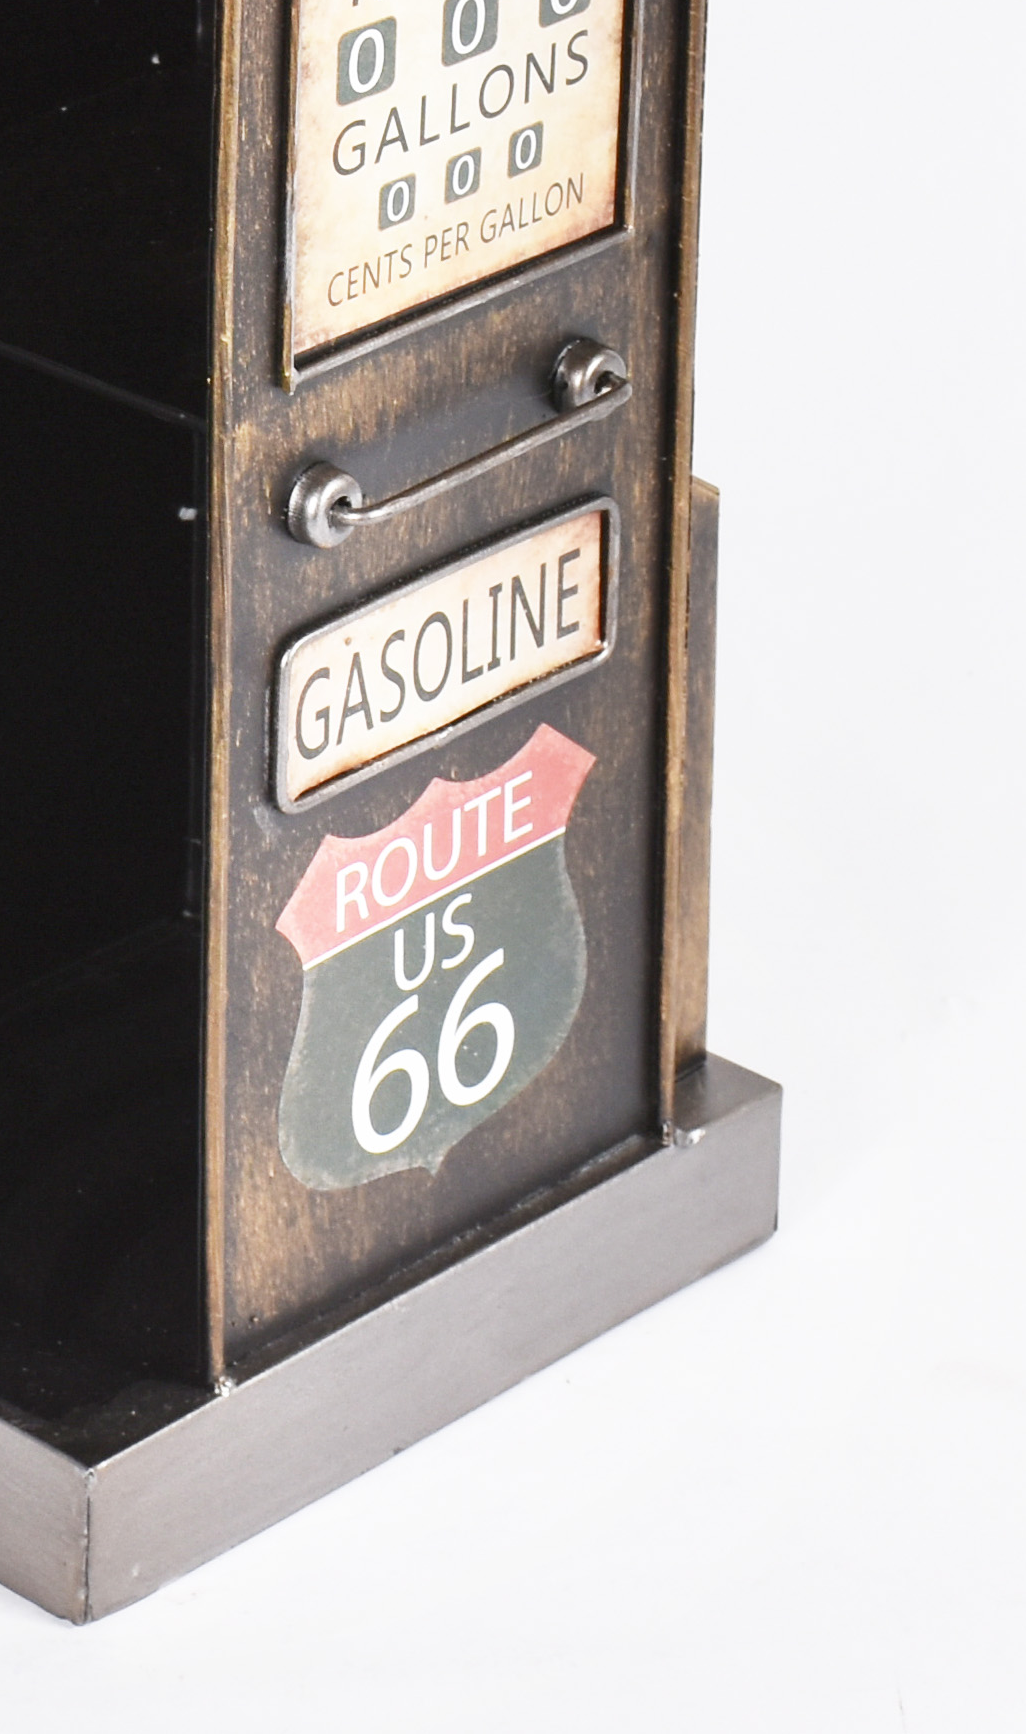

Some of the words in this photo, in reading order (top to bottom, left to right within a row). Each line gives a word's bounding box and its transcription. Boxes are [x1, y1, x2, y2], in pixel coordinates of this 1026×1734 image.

[332, 30, 590, 176] GALLONS
[349, 29, 385, 94] 0
[327, 251, 413, 308] CENTS
[424, 222, 469, 270] PER
[480, 173, 584, 244] GALLON
[387, 181, 409, 222] 0
[453, 154, 475, 196] 0
[516, 129, 536, 170] 0
[295, 548, 581, 761] GASOLINE
[336, 770, 533, 933] ROUTE
[395, 893, 474, 993] US
[351, 948, 515, 1155] 66
